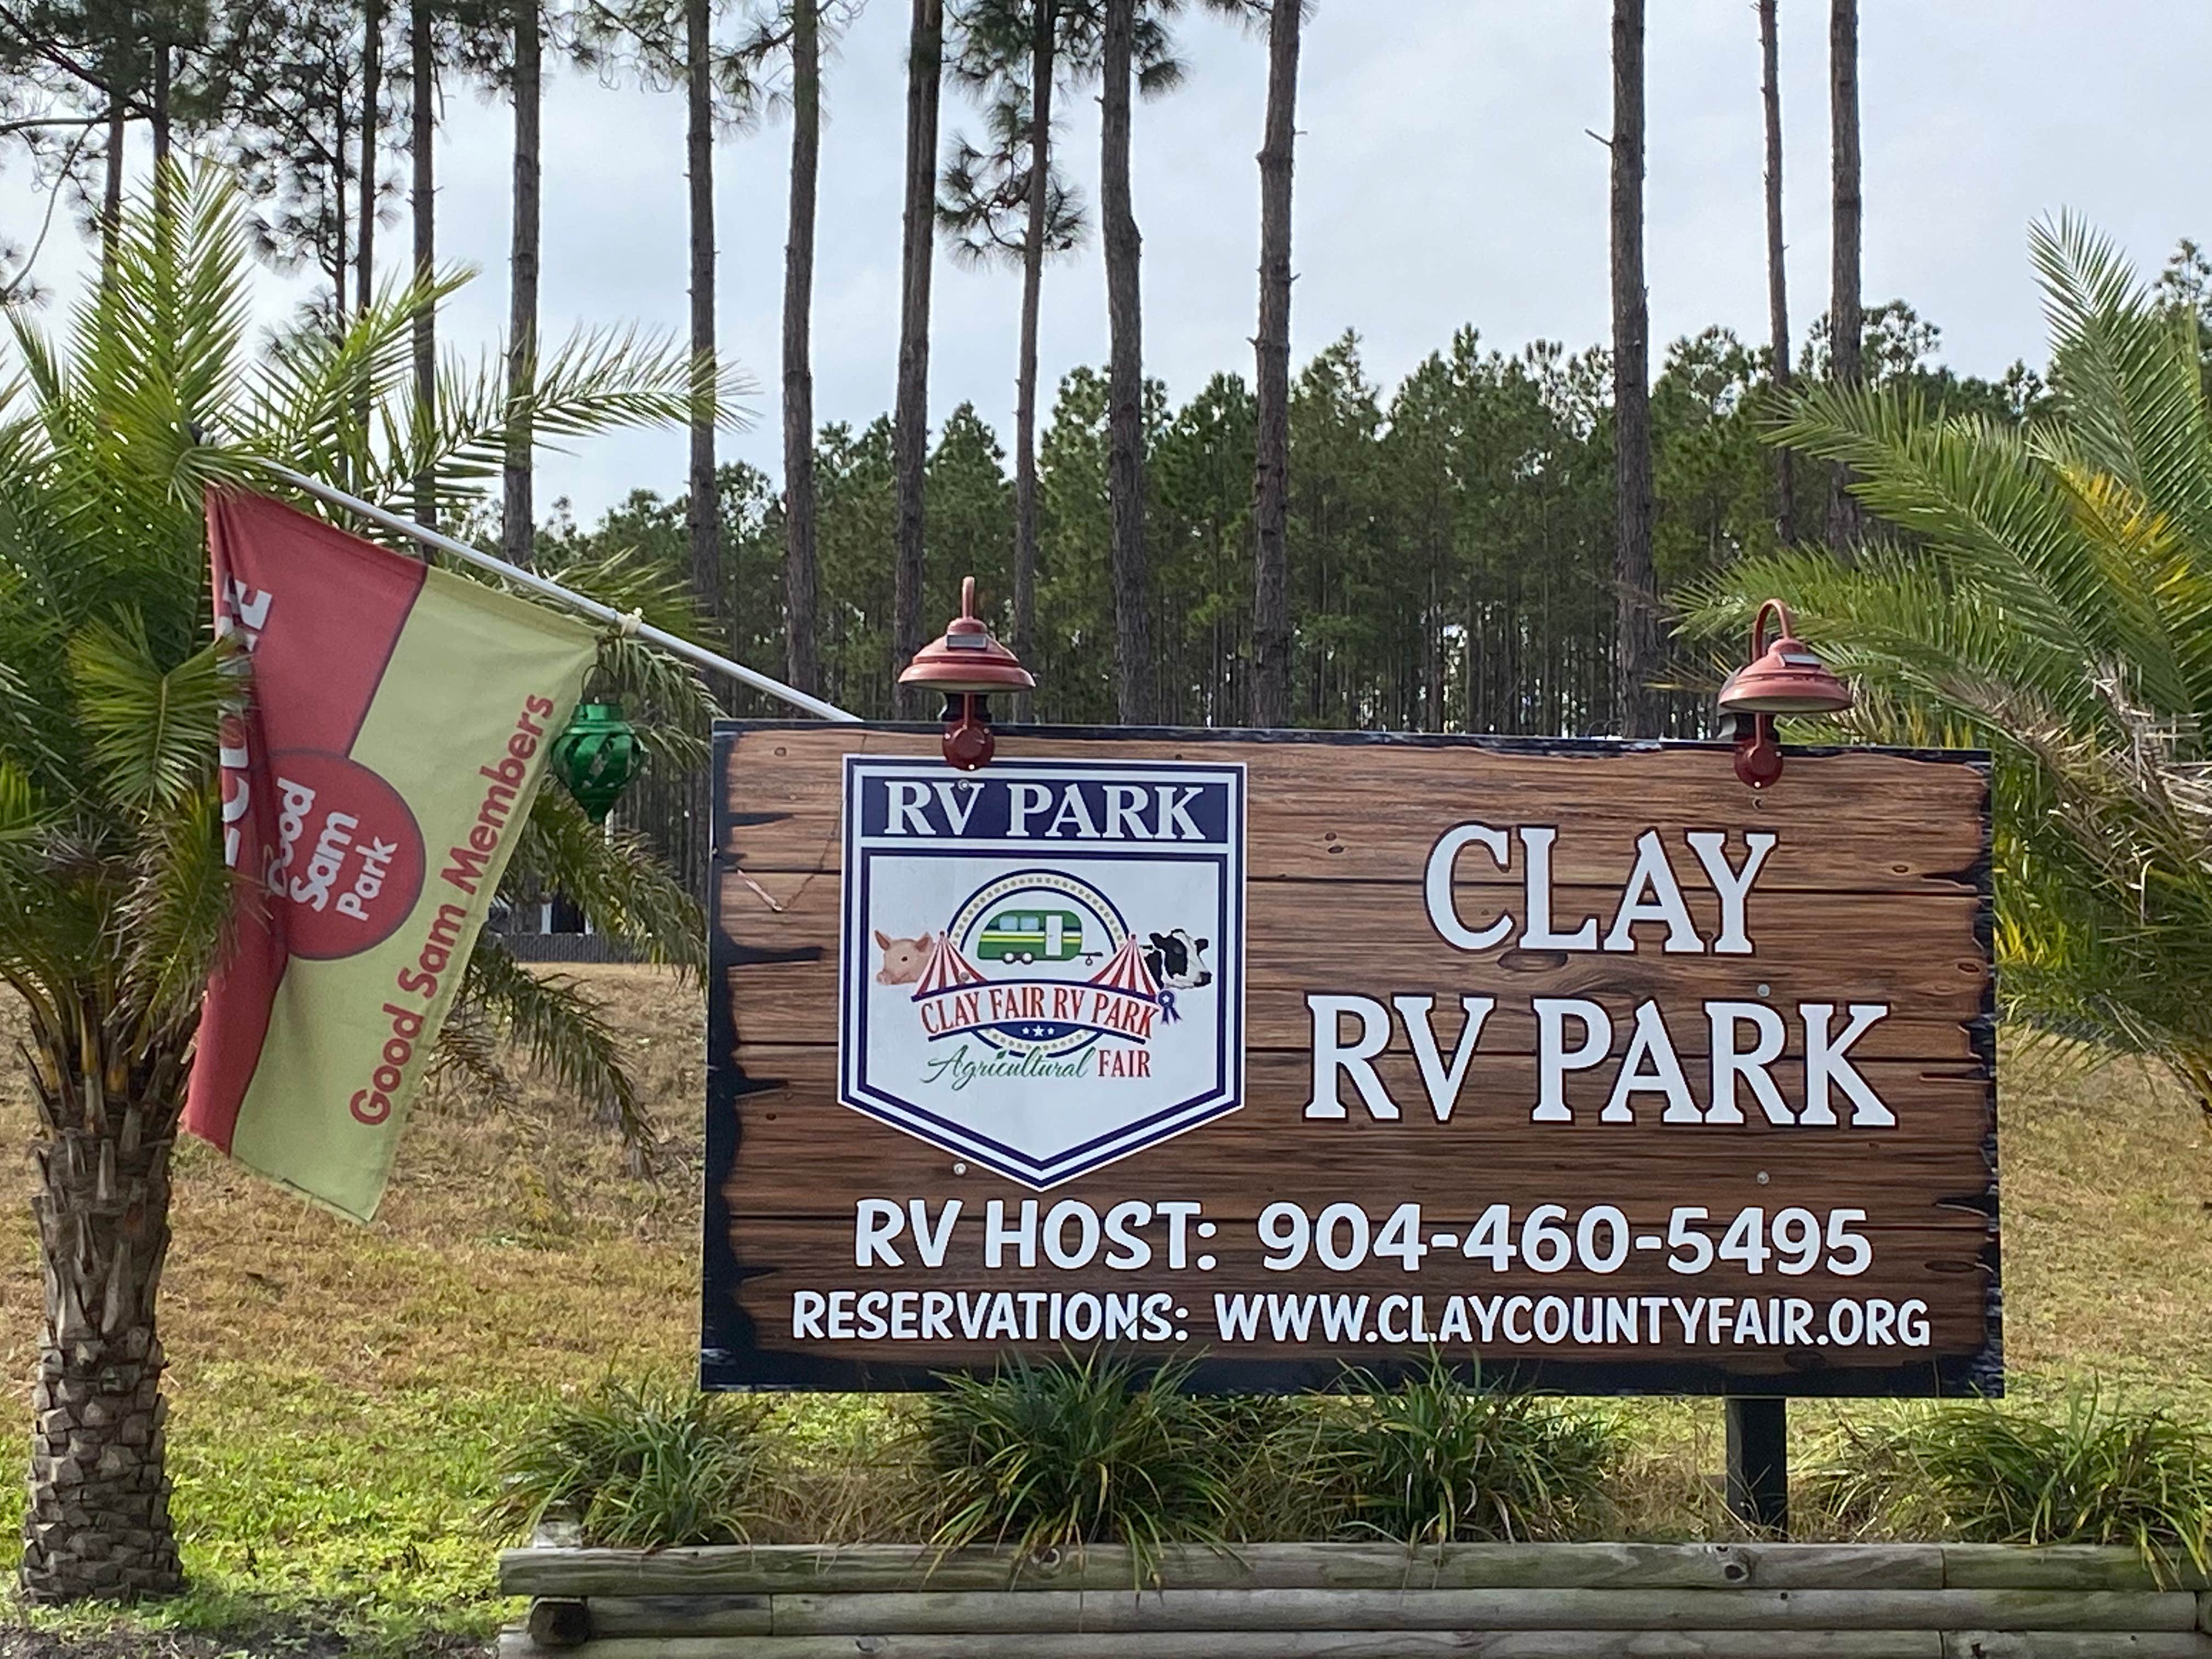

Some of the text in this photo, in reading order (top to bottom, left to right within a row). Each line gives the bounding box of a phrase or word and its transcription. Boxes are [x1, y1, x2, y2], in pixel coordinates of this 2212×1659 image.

[883, 780, 1206, 841] RV PARK
[290, 811, 359, 912] Sam
[335, 836, 398, 922] Park
[1425, 822, 1778, 955] CLAY
[349, 693, 555, 1127] Good Sam Members
[921, 986, 1159, 1039] CLAY FAIR RV PARK
[919, 1043, 1152, 1091] Agricultural FAIR
[1304, 994, 1897, 1127] RV PARK
[855, 1198, 1873, 1276] RV HOST: 904-460-5495
[792, 1290, 1931, 1347] RESERVATIONS: WWW.CLAYCOUNTYFAIR.ORG
